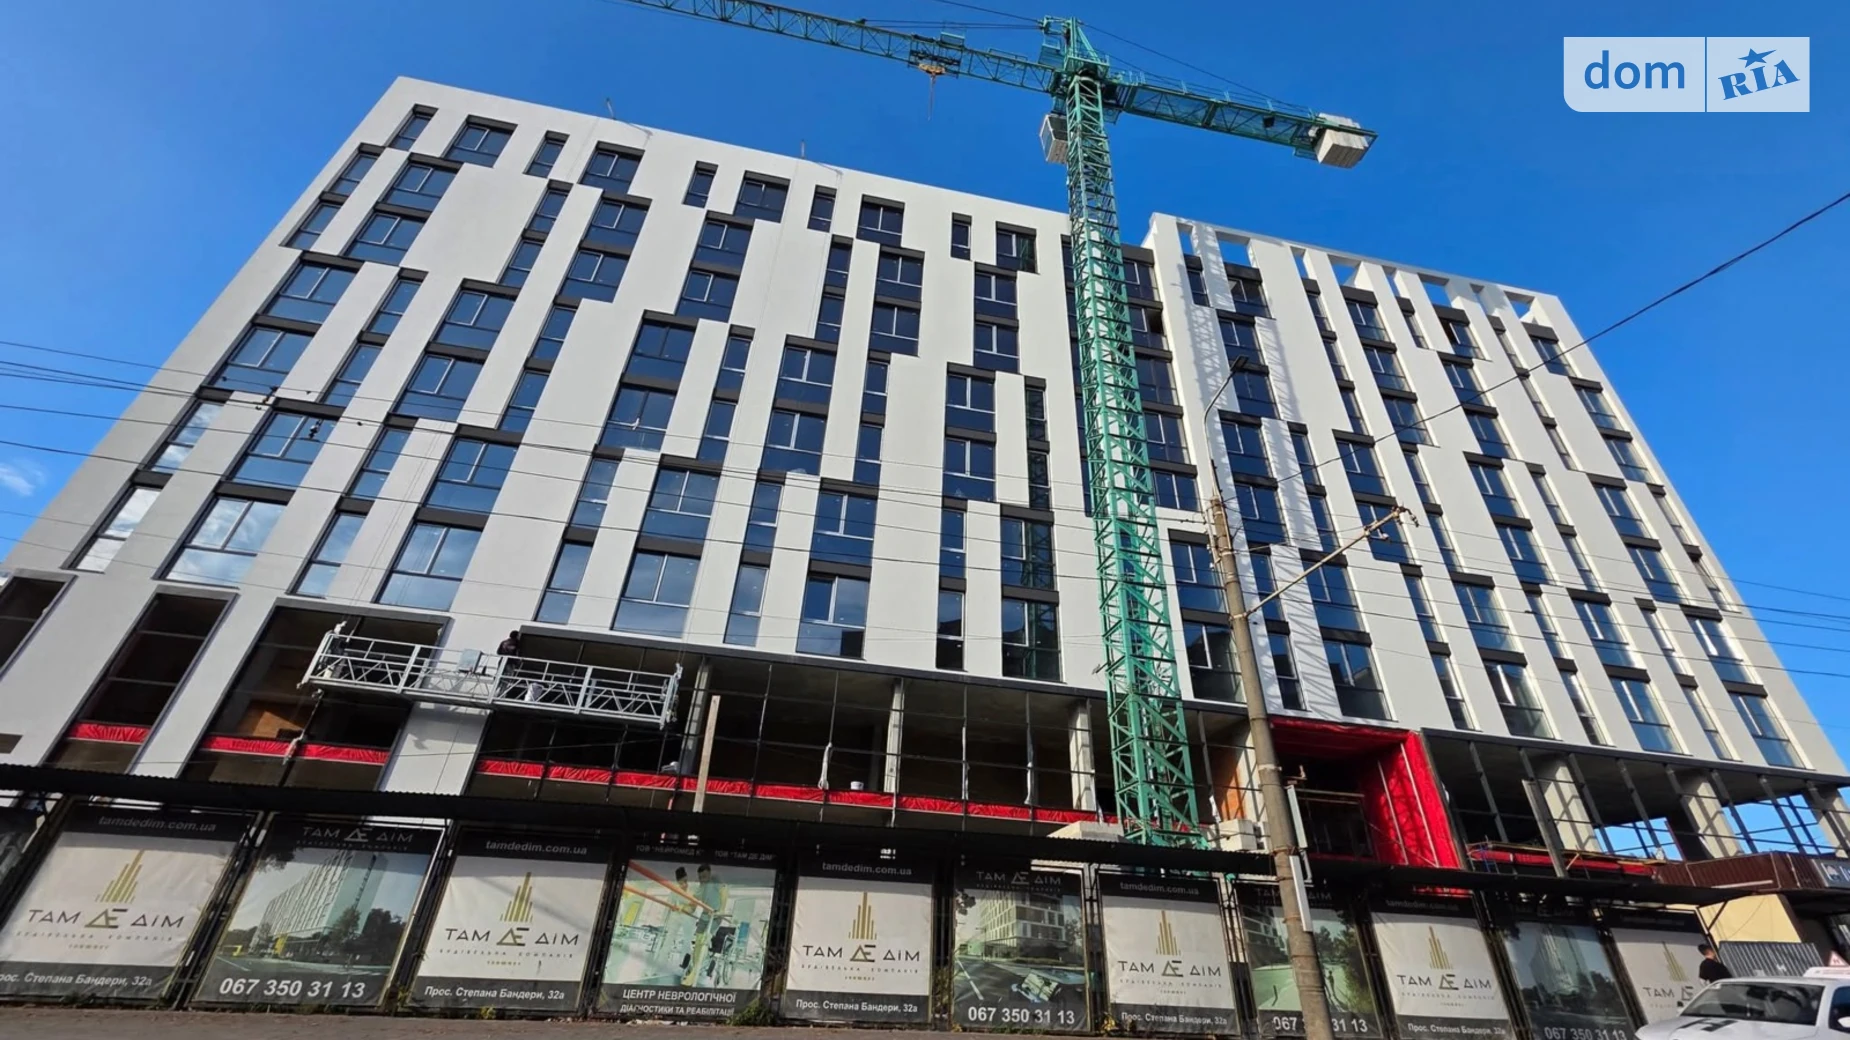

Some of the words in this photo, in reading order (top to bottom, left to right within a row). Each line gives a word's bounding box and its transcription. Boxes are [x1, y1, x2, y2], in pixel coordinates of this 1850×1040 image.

[99, 816, 217, 832] tamdedim.com.ua
[486, 840, 588, 855] tamdedim.com.ua
[822, 861, 912, 876] tamdedim.com.ua
[24, 972, 73, 984] Степана
[75, 974, 128, 987] Бандери,
[219, 978, 260, 995] 067
[264, 979, 302, 996] 350
[307, 981, 333, 997] 31
[341, 982, 366, 998] 13
[424, 986, 452, 998] Прос.
[455, 987, 497, 998] Степана
[499, 988, 545, 1001] Бандери,
[623, 989, 656, 1000] ЦЕНТР
[658, 990, 737, 1003] НЕВРОЛОГІЧНОЇ
[620, 1004, 674, 1014] ДІАГНОСТИКИ
[675, 1006, 685, 1014] ТА
[796, 999, 820, 1010] Прос.
[823, 1000, 859, 1011] Степана
[861, 1002, 901, 1013] Бандери,
[968, 1006, 997, 1022] 067
[1002, 1008, 1030, 1023] 350
[1034, 1009, 1051, 1023] 31
[1057, 1010, 1075, 1024] 13
[1351, 1019, 1368, 1032] 13
